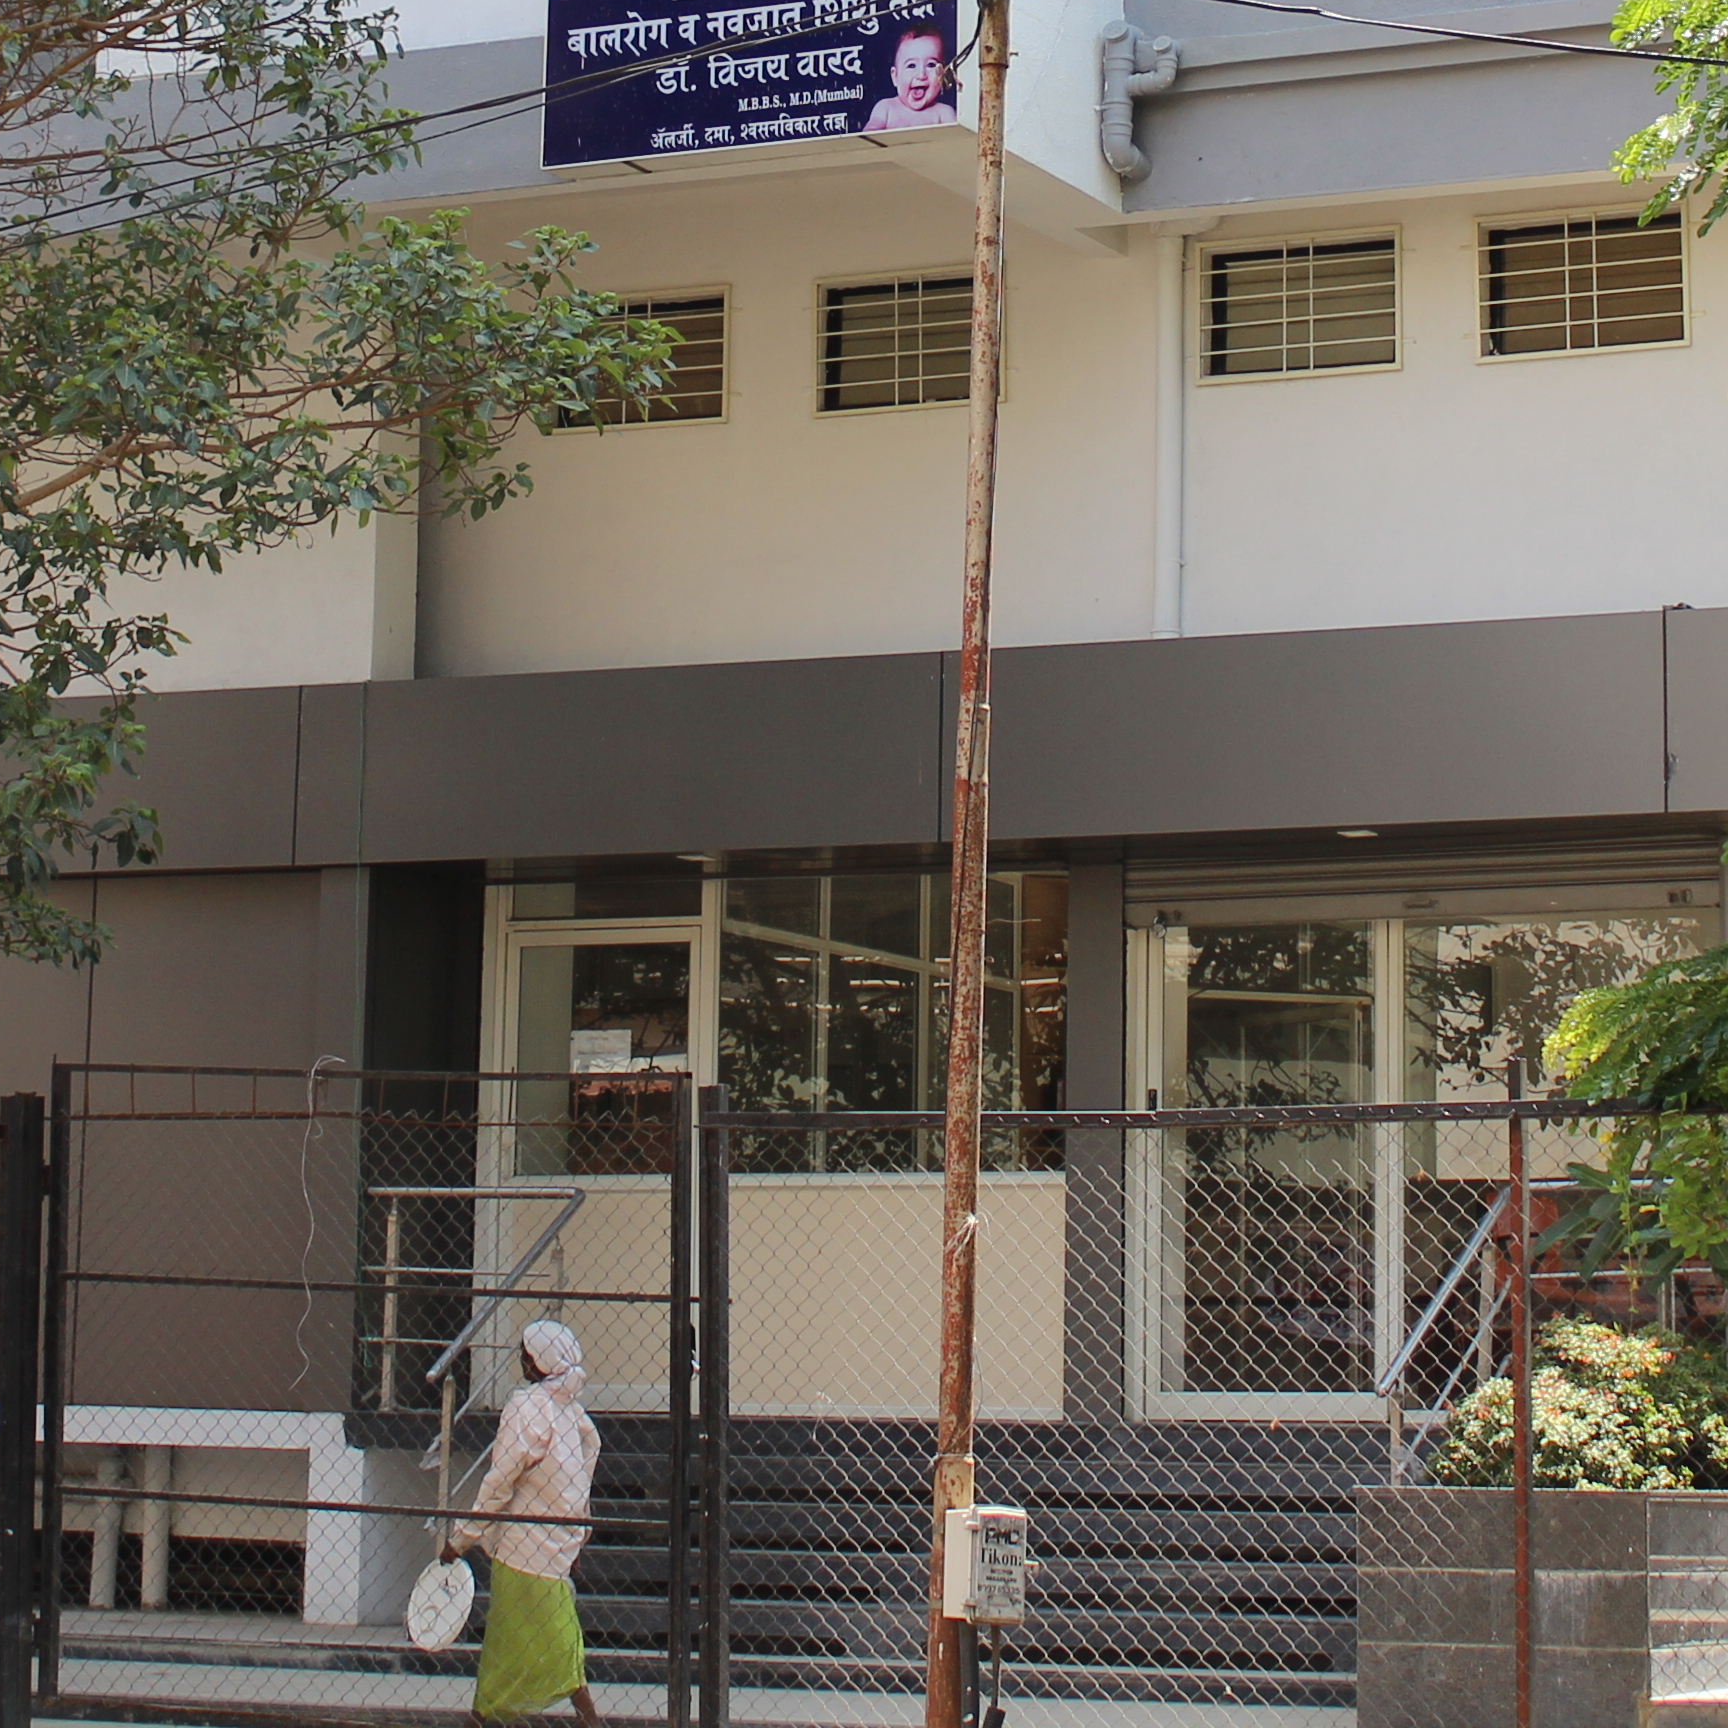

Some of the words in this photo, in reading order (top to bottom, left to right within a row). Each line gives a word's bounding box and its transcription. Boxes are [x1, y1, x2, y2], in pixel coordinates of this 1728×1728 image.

[567, 10, 673, 57] बालरोग
[678, 15, 700, 45] व
[706, 1, 806, 39] नवजात
[656, 55, 696, 94] डॉ.
[707, 53, 789, 88] विजय
[796, 45, 863, 77] वारद
[704, 125, 735, 144] दमा,
[740, 113, 821, 140] श्वसनविकार
